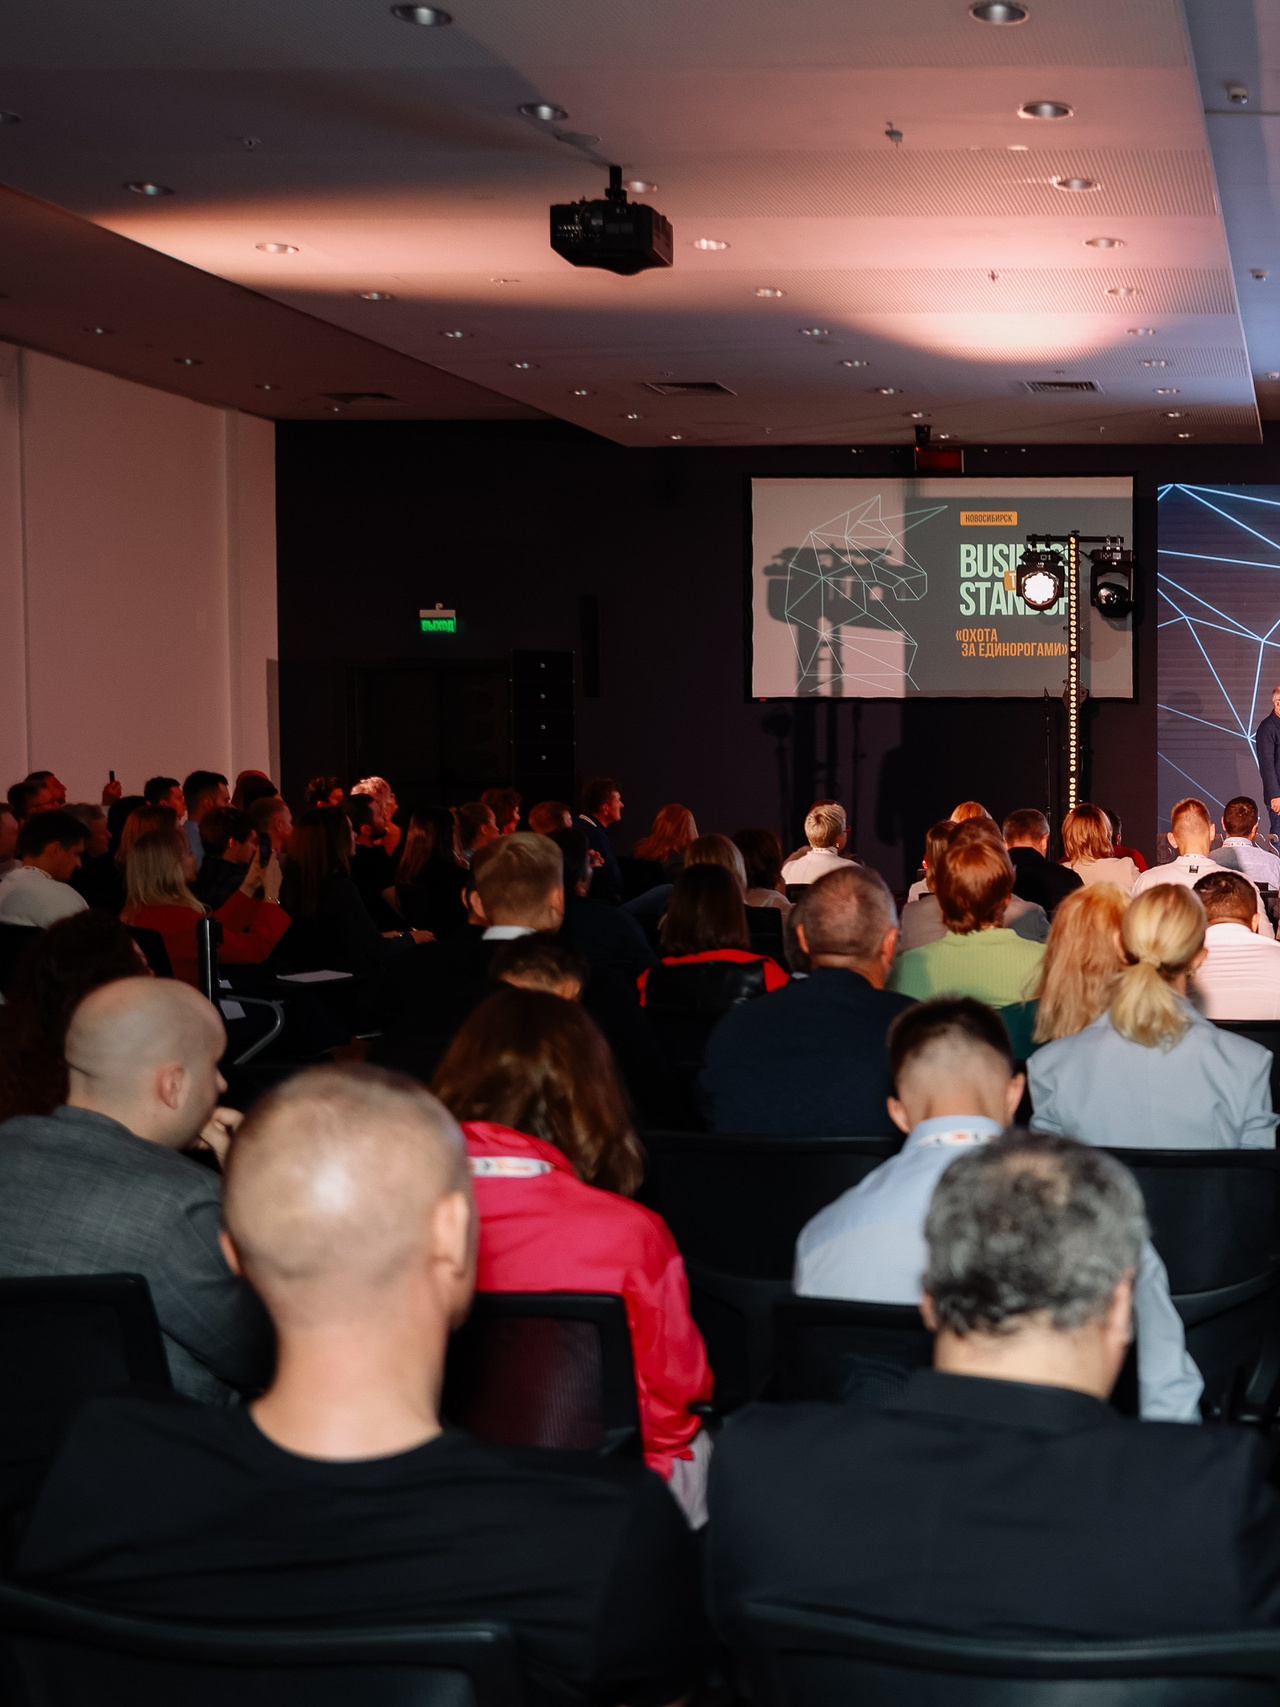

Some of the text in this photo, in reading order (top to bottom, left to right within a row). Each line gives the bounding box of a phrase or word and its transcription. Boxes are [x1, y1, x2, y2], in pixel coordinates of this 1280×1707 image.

[965, 514, 1013, 523] НОВОСИБИРСК
[956, 629, 998, 642] «ОХОТА
[961, 643, 1068, 658] ЗА ЕДИНОРОГАМИ»
